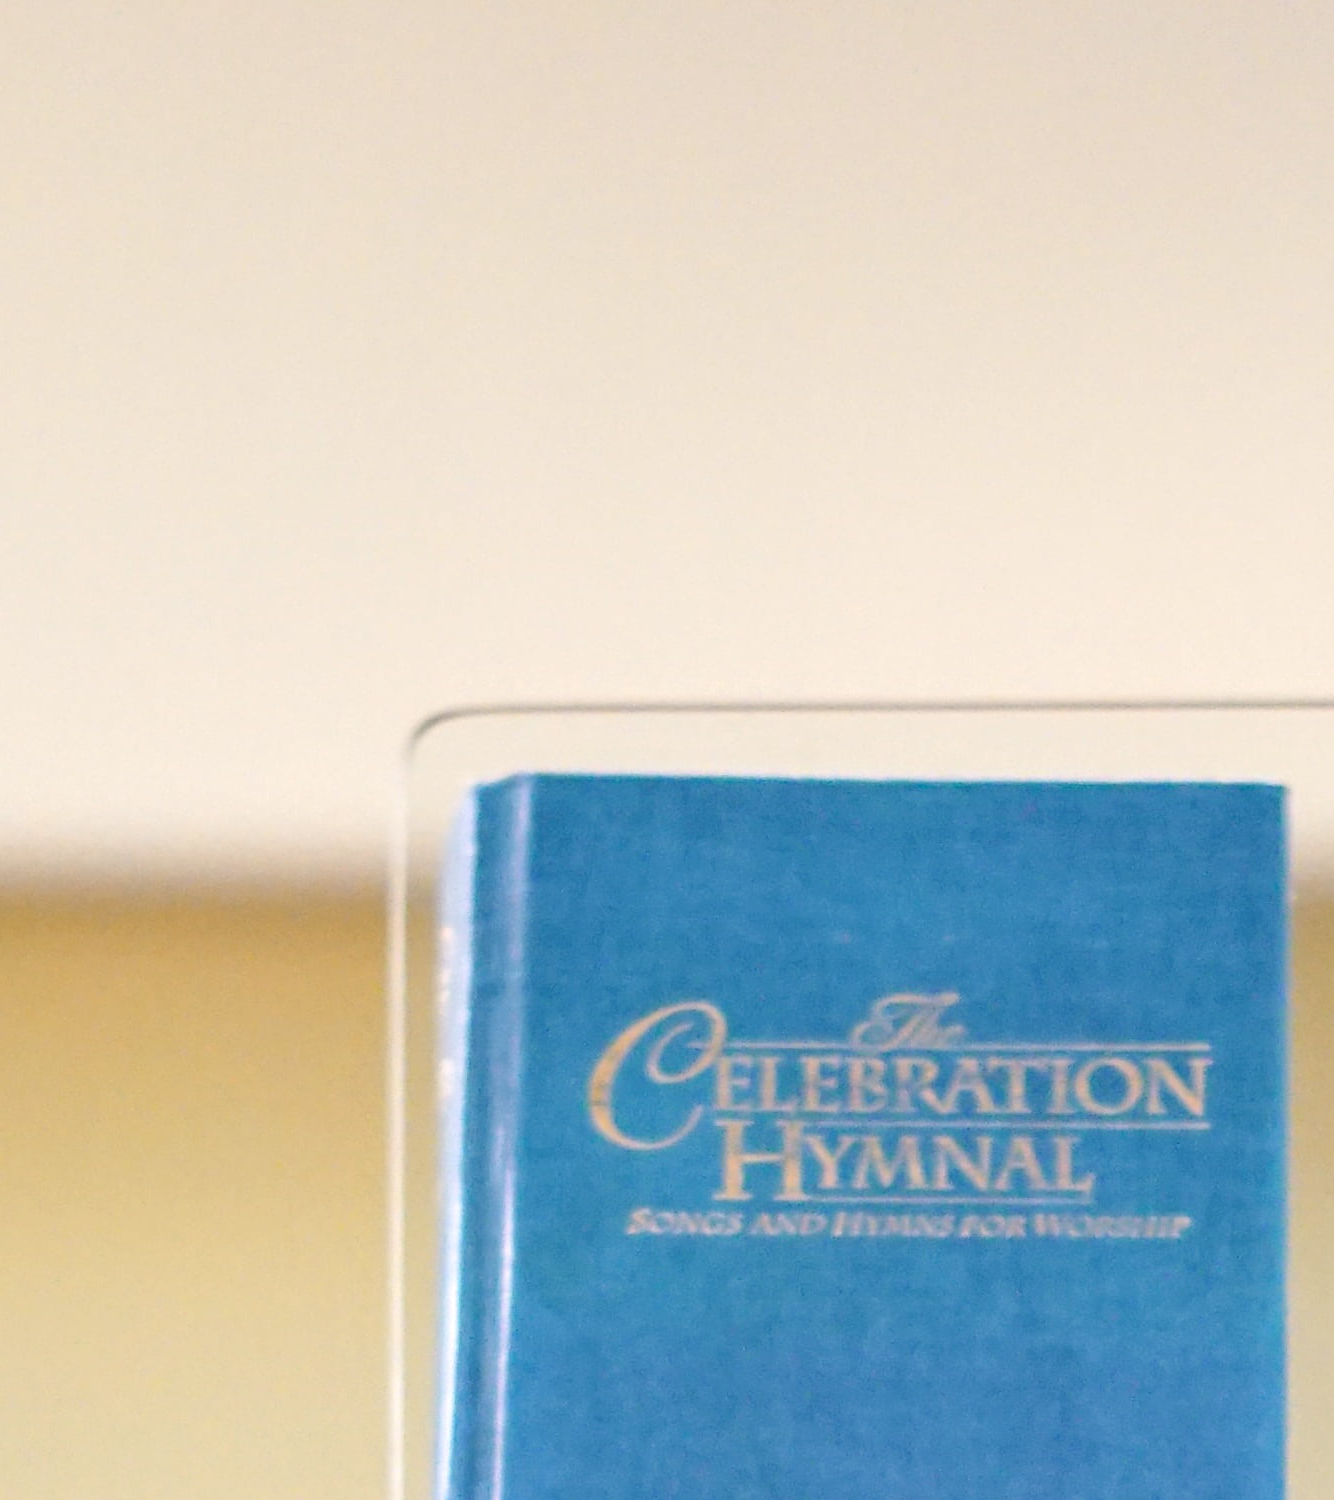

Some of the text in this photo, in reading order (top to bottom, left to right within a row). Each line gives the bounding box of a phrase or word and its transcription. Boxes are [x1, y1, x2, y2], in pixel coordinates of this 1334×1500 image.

[852, 993, 966, 1050] The
[587, 1001, 1211, 1150] CELEBRATION
[714, 1120, 1095, 1200] HYMNAL
[627, 1207, 1193, 1239] SONGS AND HYMNS FOR WORSHIP
